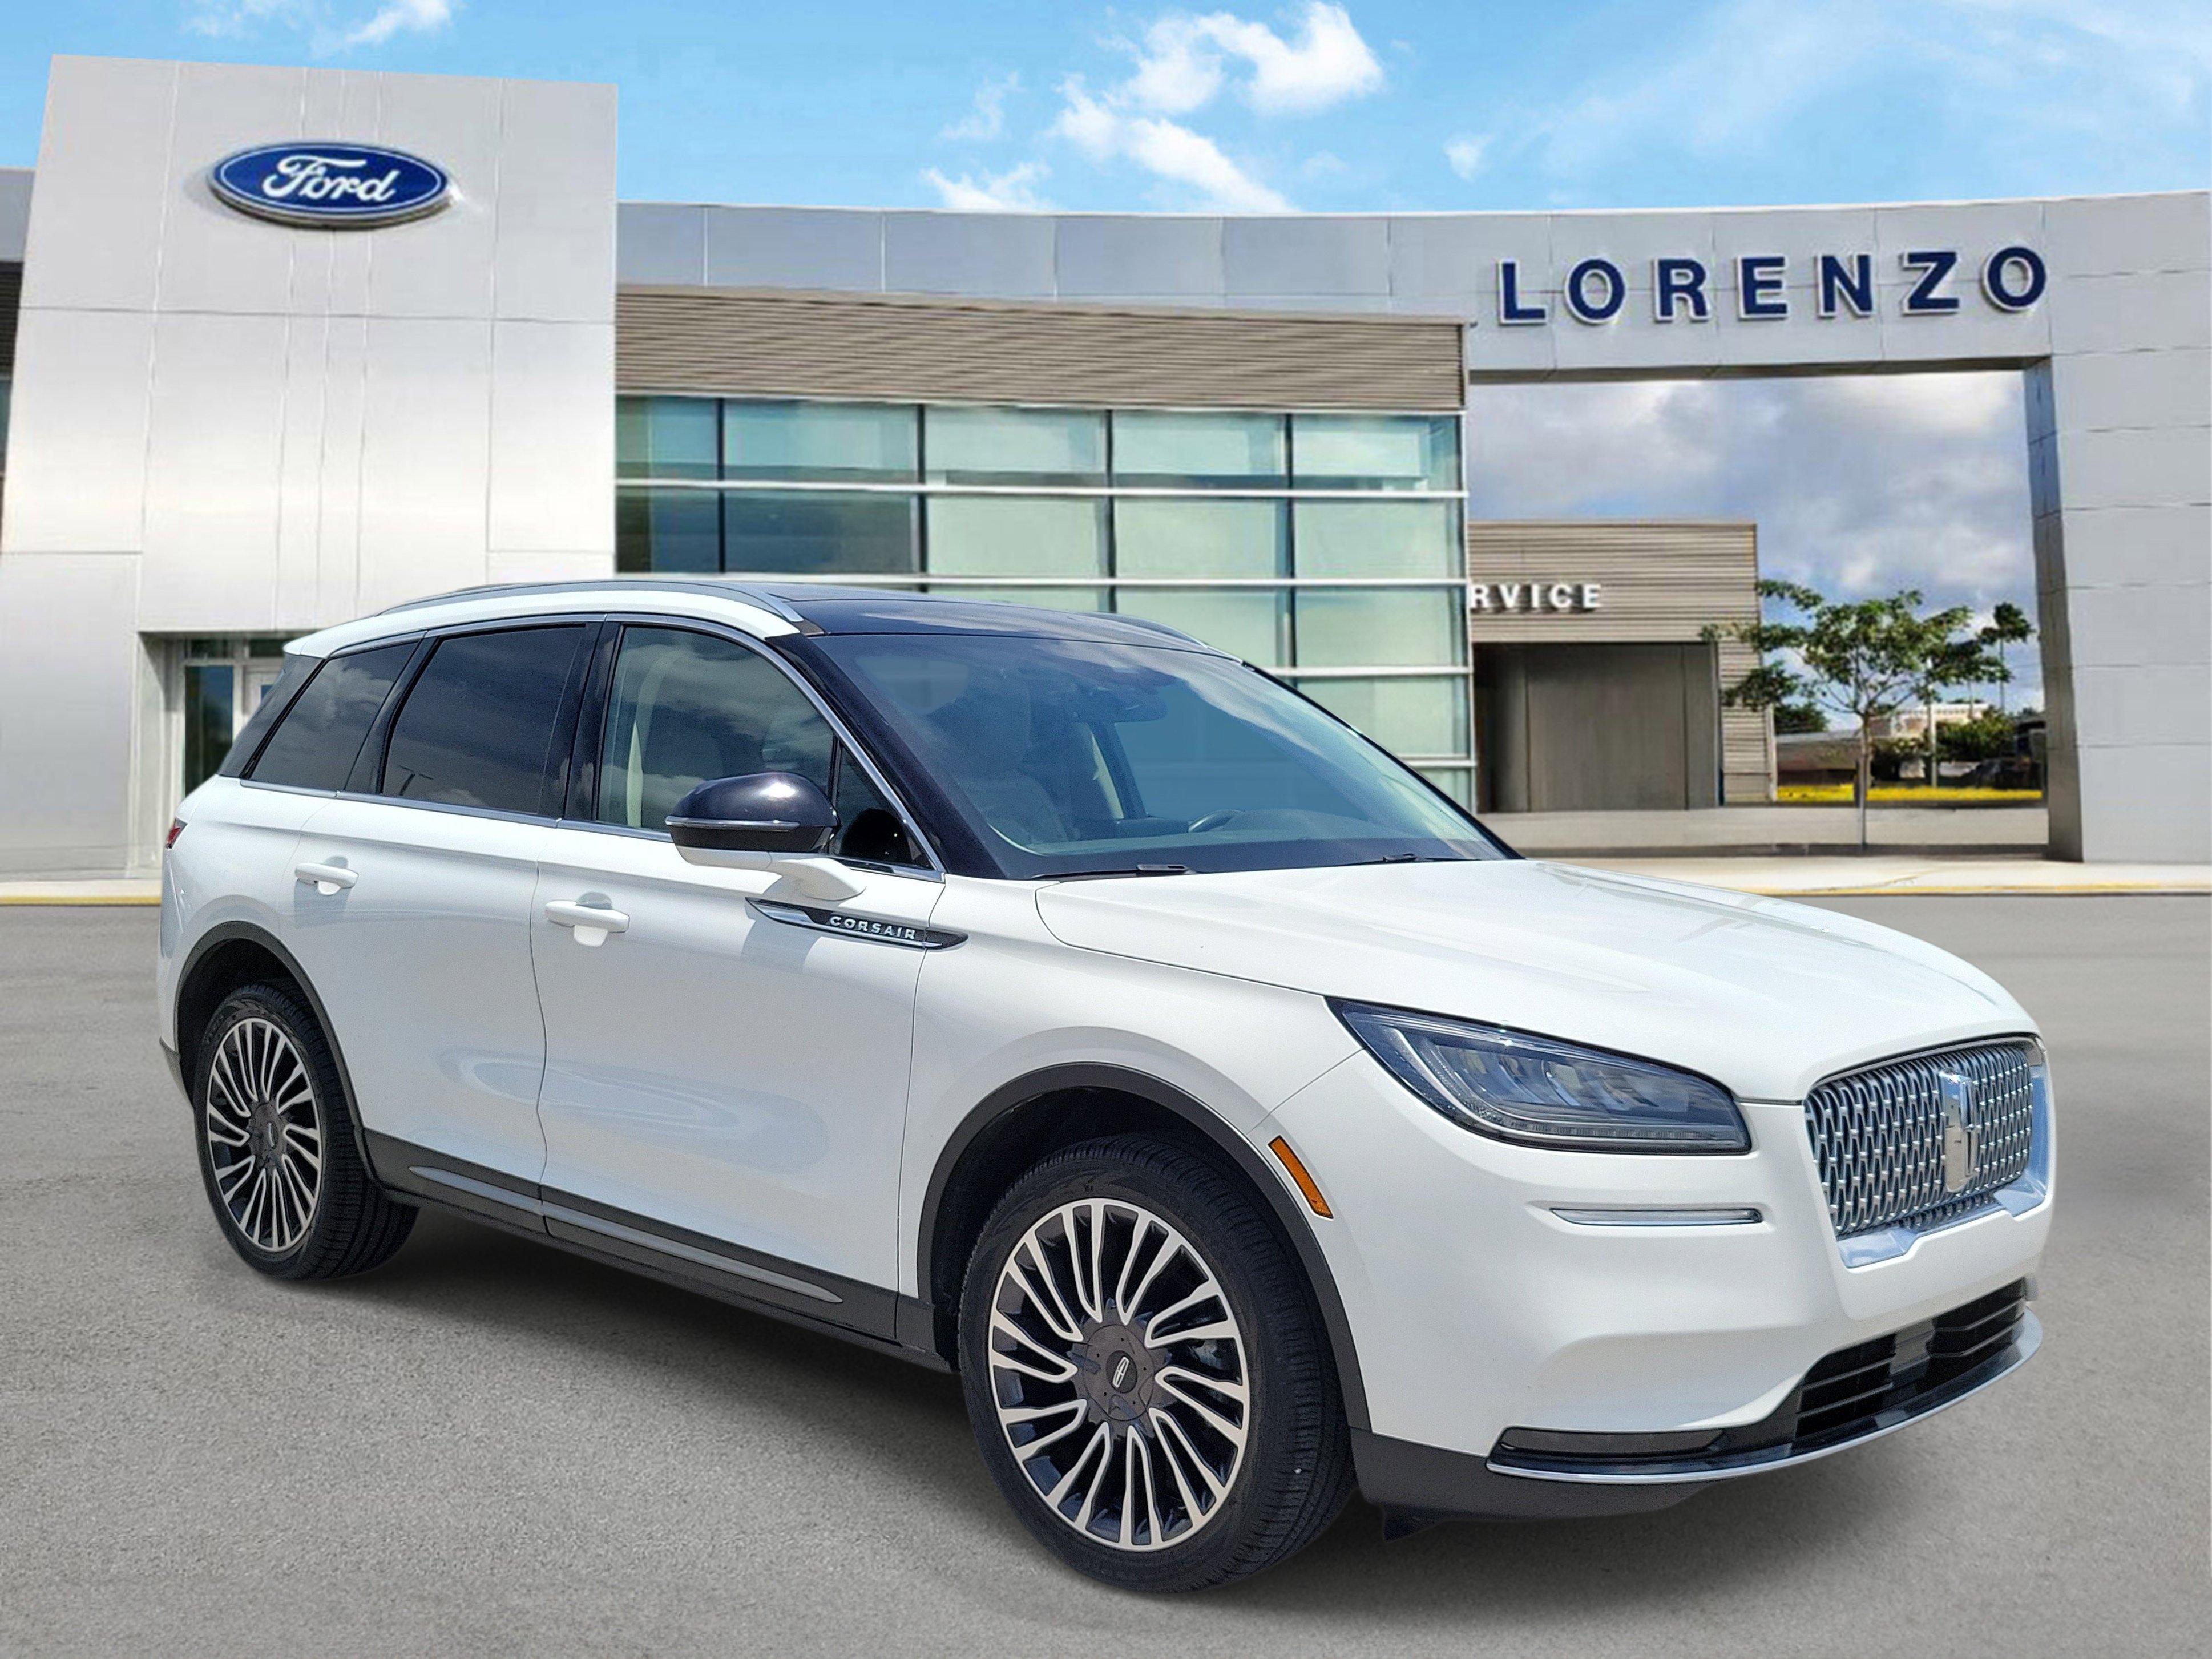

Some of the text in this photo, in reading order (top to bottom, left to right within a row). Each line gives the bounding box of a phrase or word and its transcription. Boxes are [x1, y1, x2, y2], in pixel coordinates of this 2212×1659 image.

[262, 155, 401, 202] Ford
[1499, 246, 2047, 326] LORENZO
[1470, 583, 1603, 608] RVICE
[830, 915, 916, 939] CORSAIR
